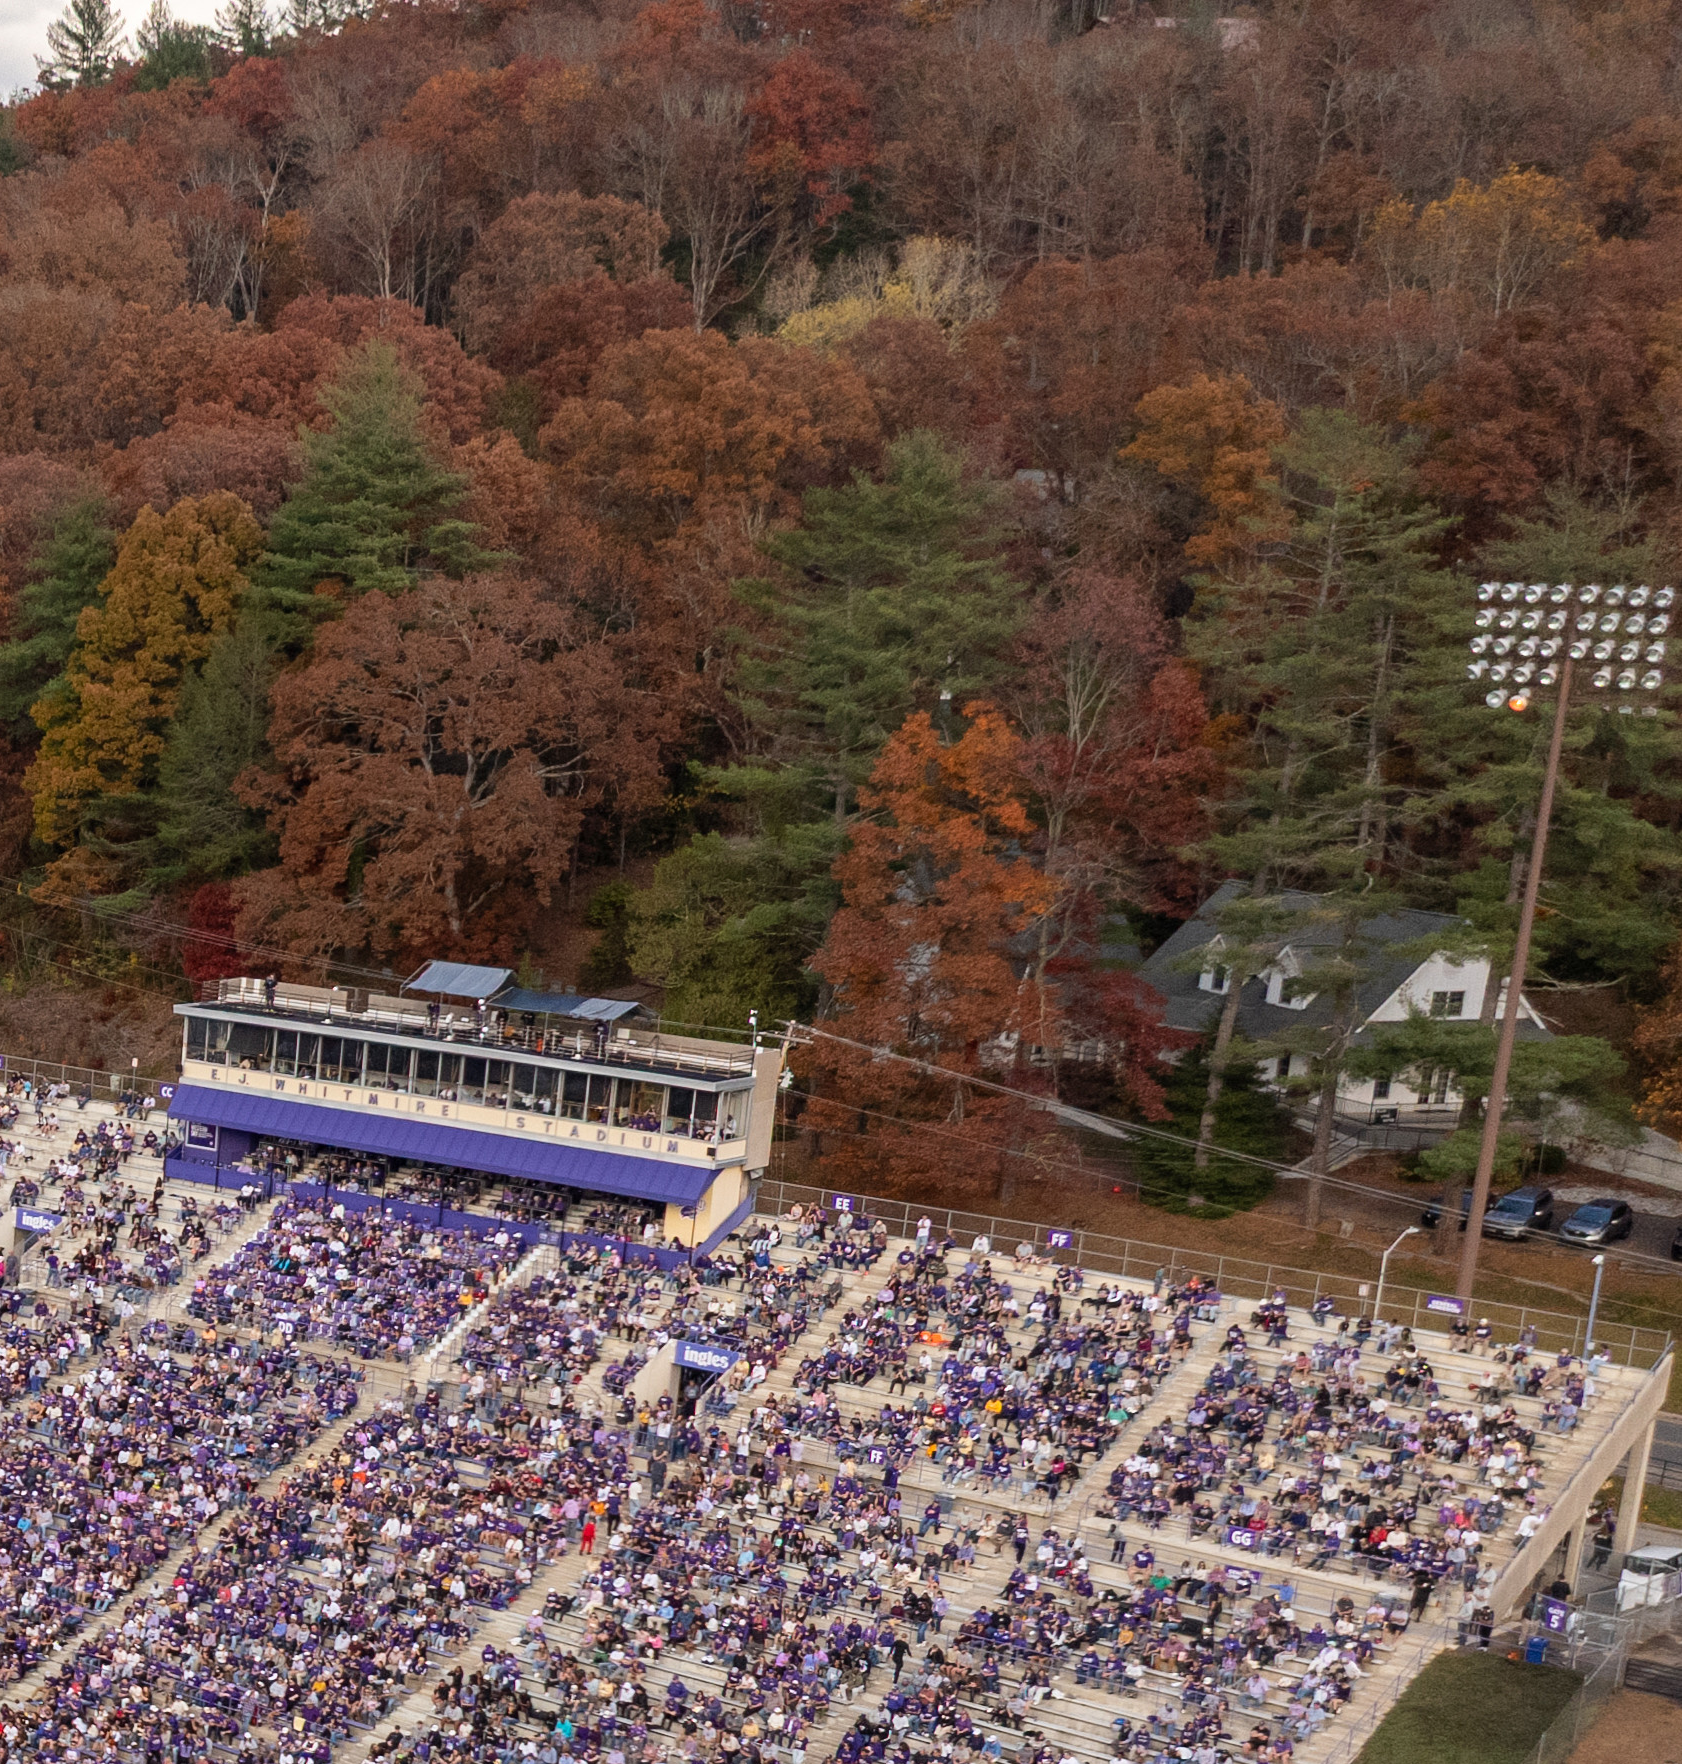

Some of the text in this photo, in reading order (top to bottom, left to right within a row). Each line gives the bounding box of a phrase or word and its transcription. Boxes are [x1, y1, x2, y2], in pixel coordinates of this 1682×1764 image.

[161, 1086, 174, 1098] CC
[212, 1069, 679, 1154] E. J. WHITMIRE STADIUM
[835, 1197, 851, 1211] EE
[22, 1212, 55, 1231] ingles
[1051, 1232, 1069, 1248] FF
[278, 1320, 294, 1335] DD
[230, 1347, 240, 1359] D
[684, 1345, 729, 1369] ingles
[870, 1449, 884, 1464] FF
[1231, 1530, 1252, 1546] GG
[1549, 1614, 1560, 1629] 5
